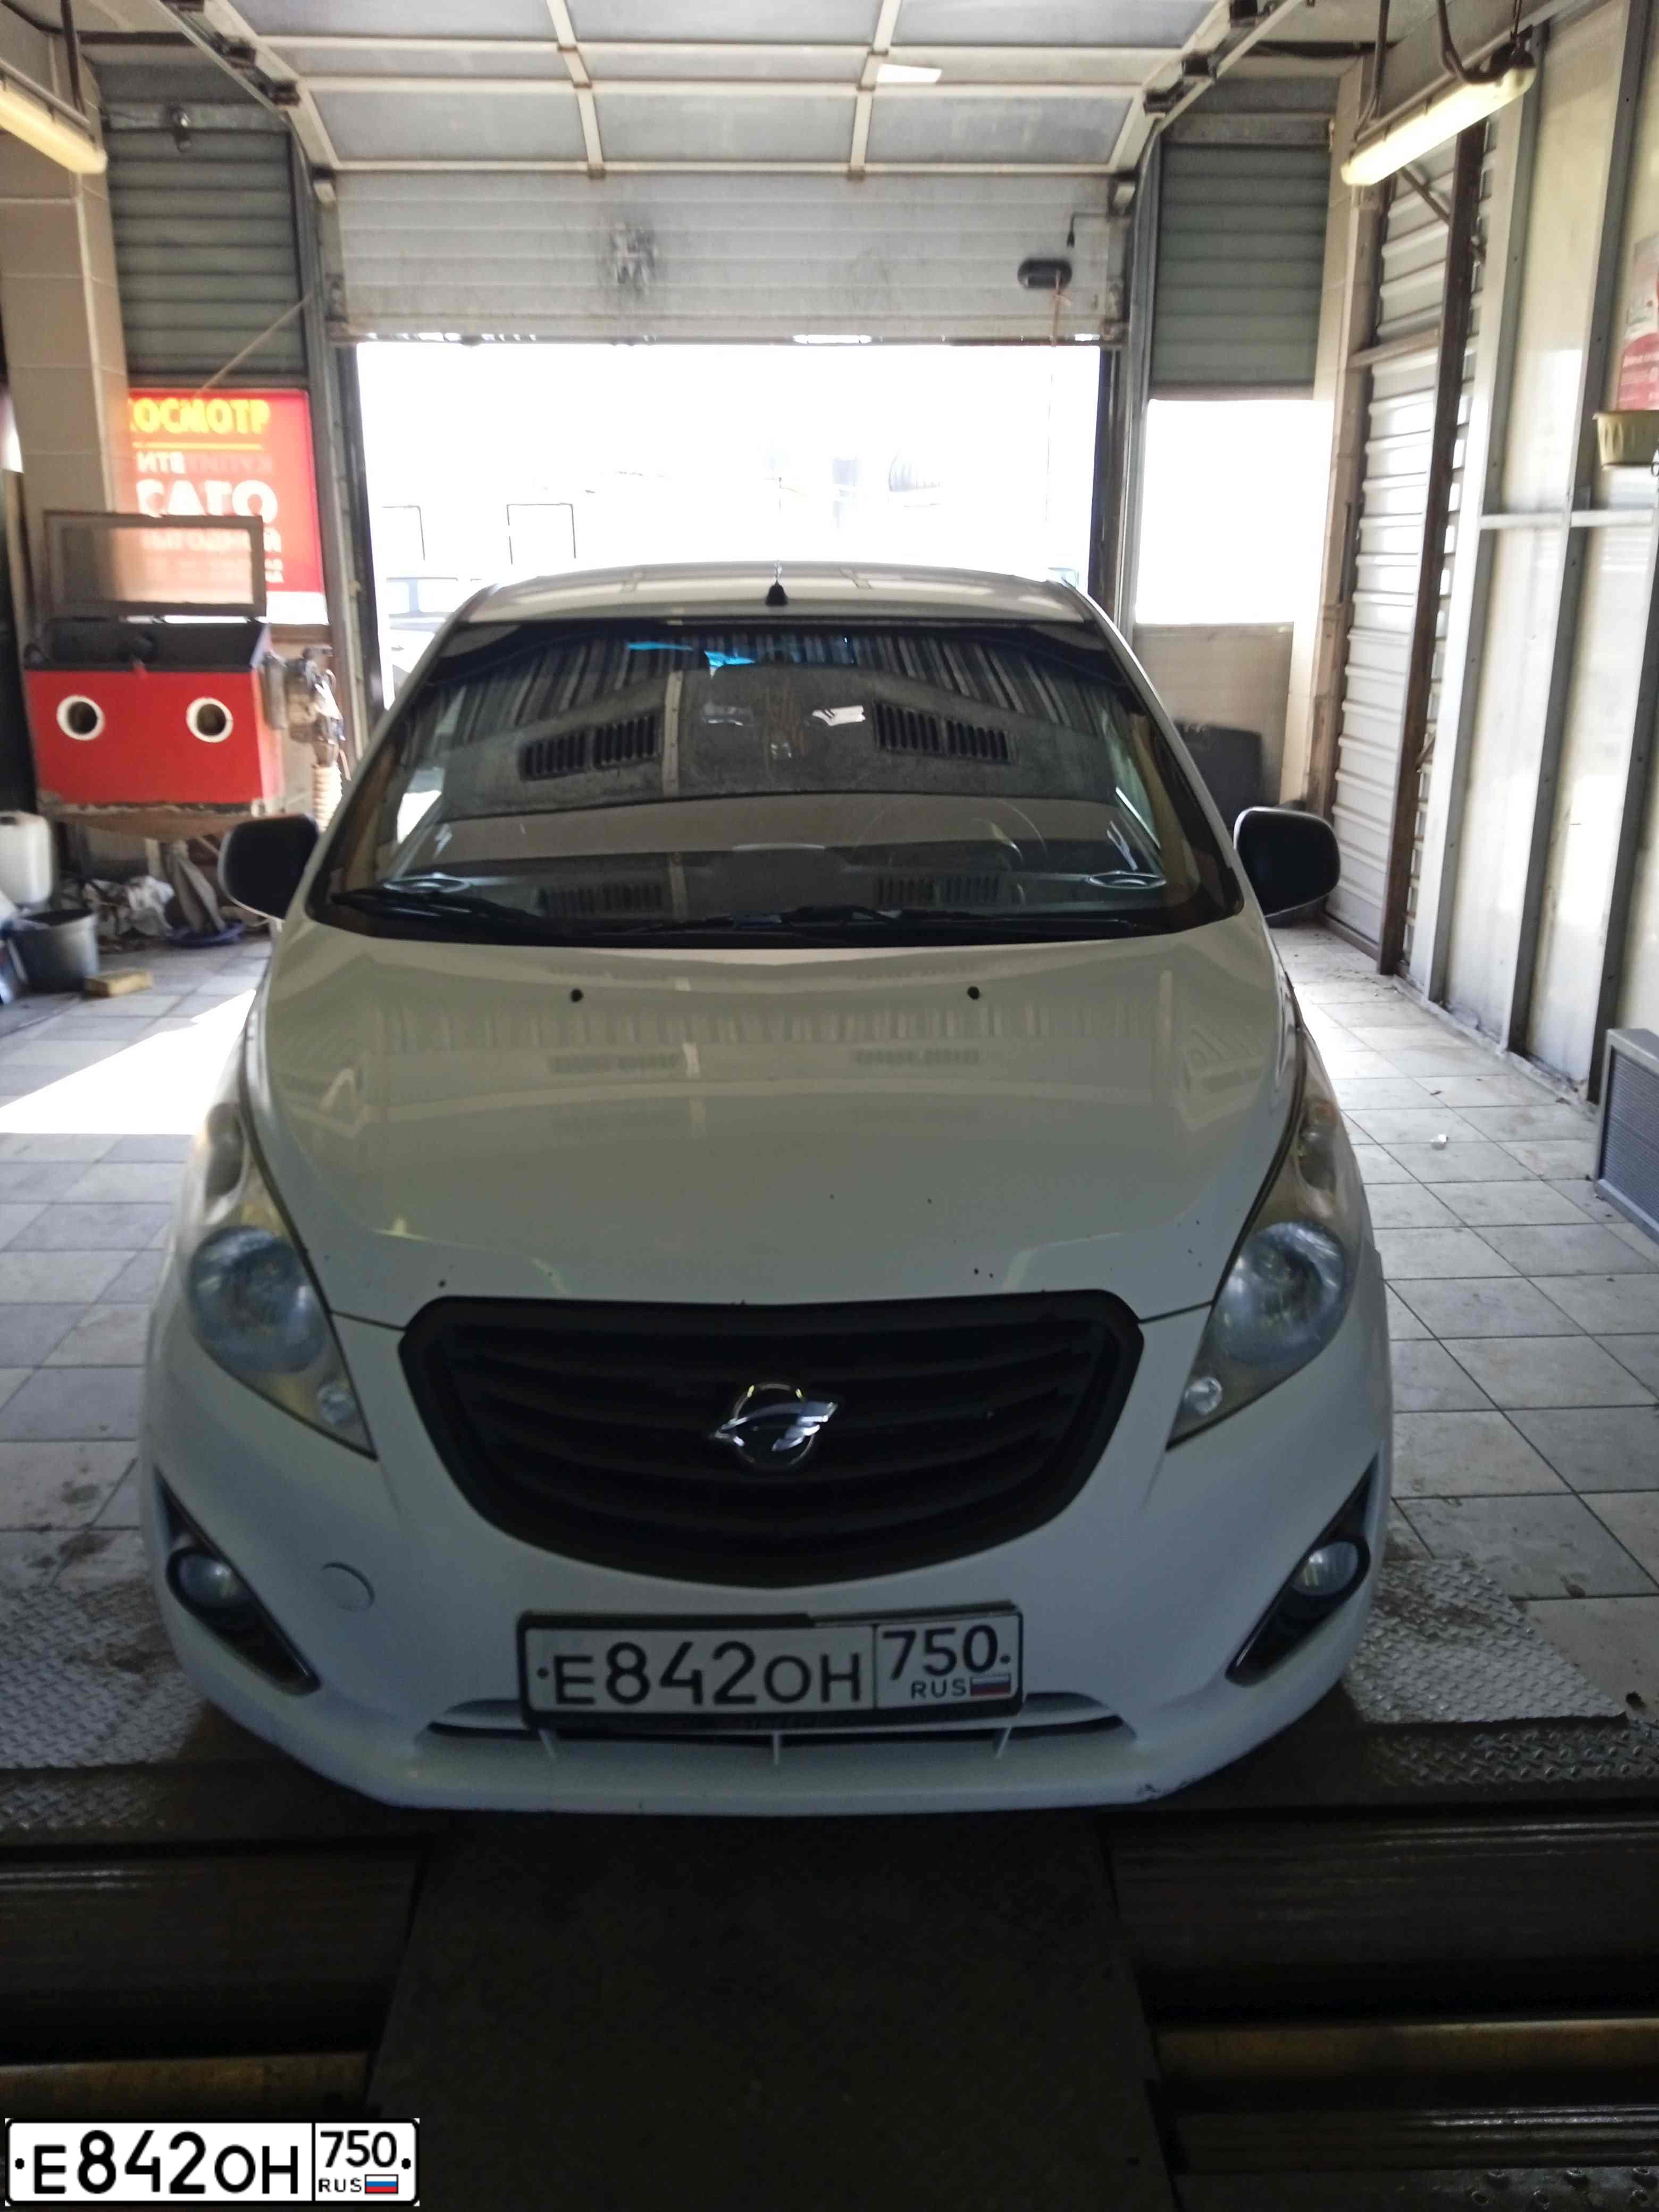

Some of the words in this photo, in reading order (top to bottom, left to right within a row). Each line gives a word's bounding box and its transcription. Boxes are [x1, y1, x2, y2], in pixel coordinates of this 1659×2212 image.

[128, 397, 270, 434] ОСМОТР
[882, 1624, 998, 1681] 750
[910, 1677, 967, 1699] RUS
